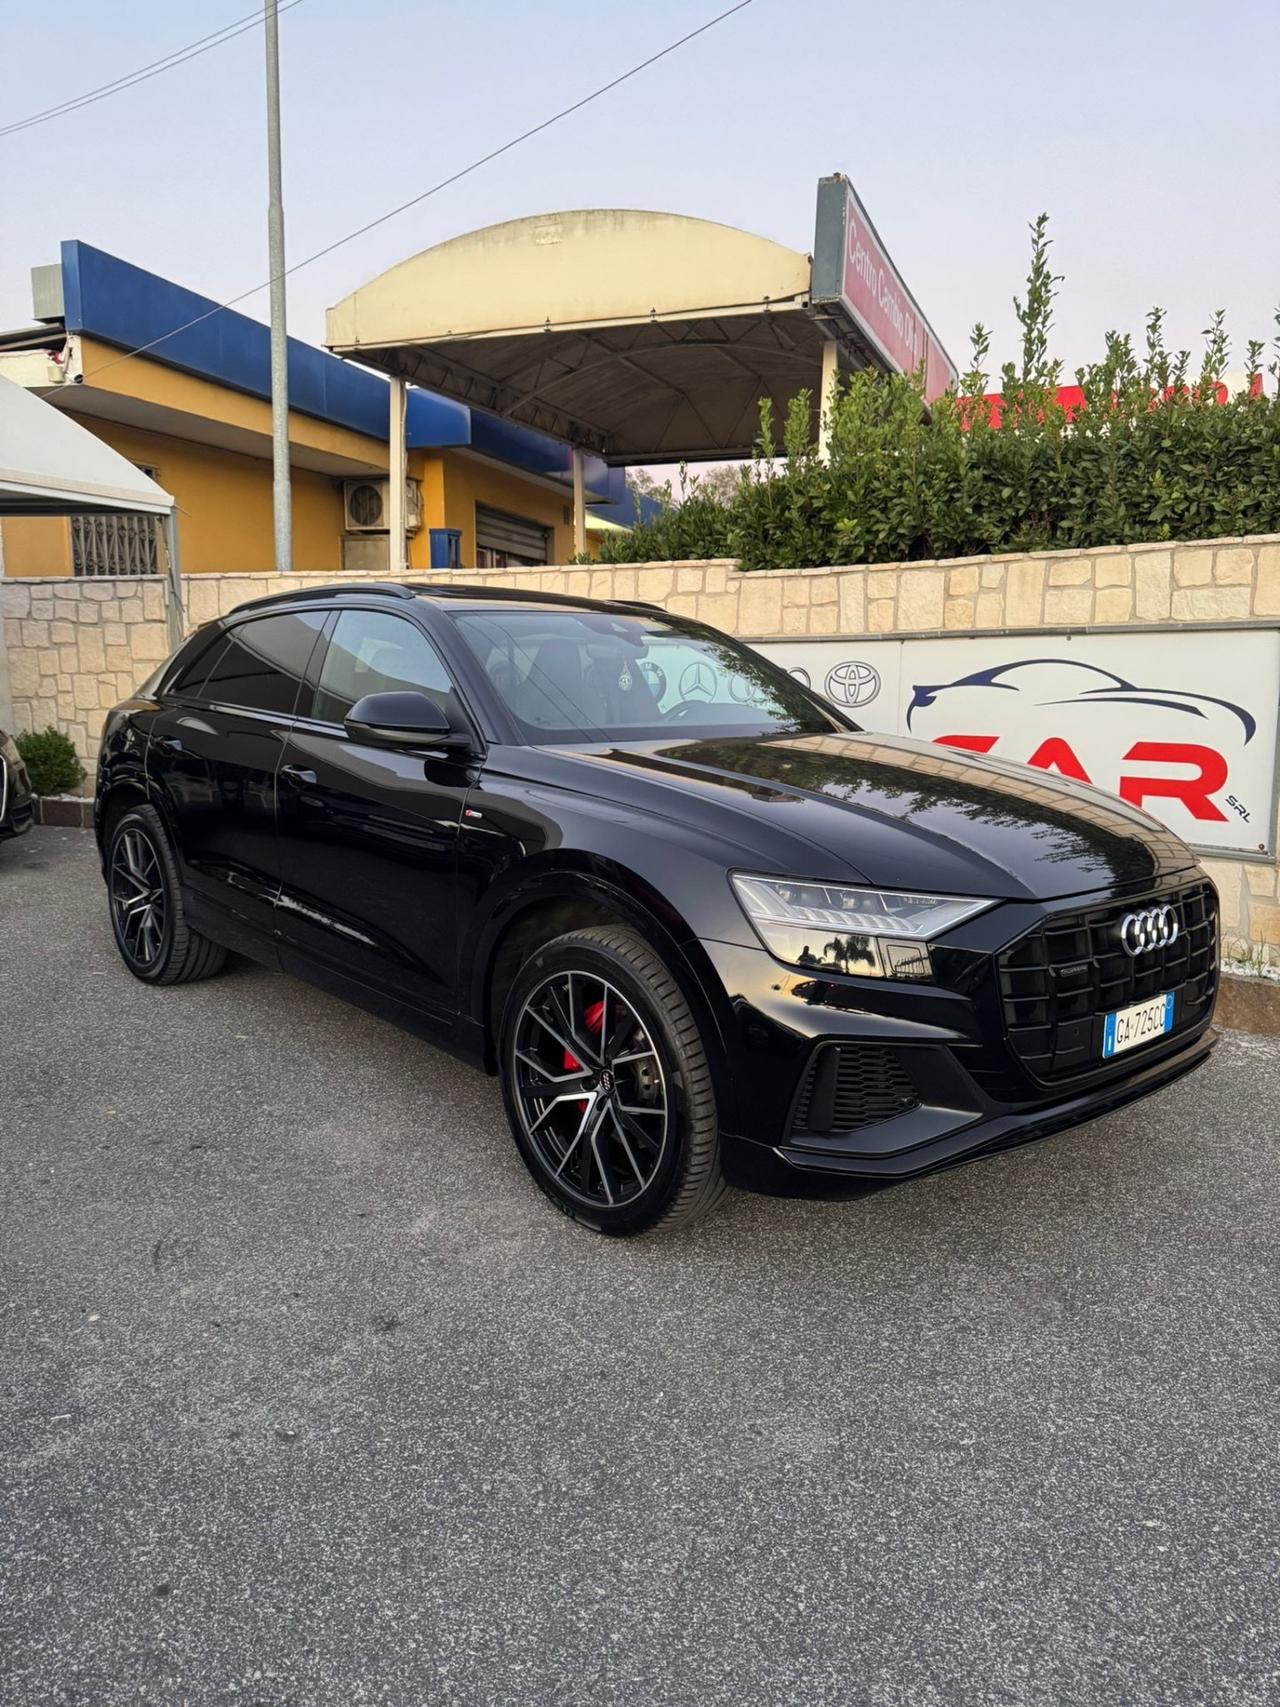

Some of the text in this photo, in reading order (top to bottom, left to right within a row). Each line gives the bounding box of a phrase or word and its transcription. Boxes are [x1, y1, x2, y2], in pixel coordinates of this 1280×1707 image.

[849, 218, 877, 297] Centro
[878, 268, 904, 338] Cambio
[1225, 795, 1250, 823] SRL
